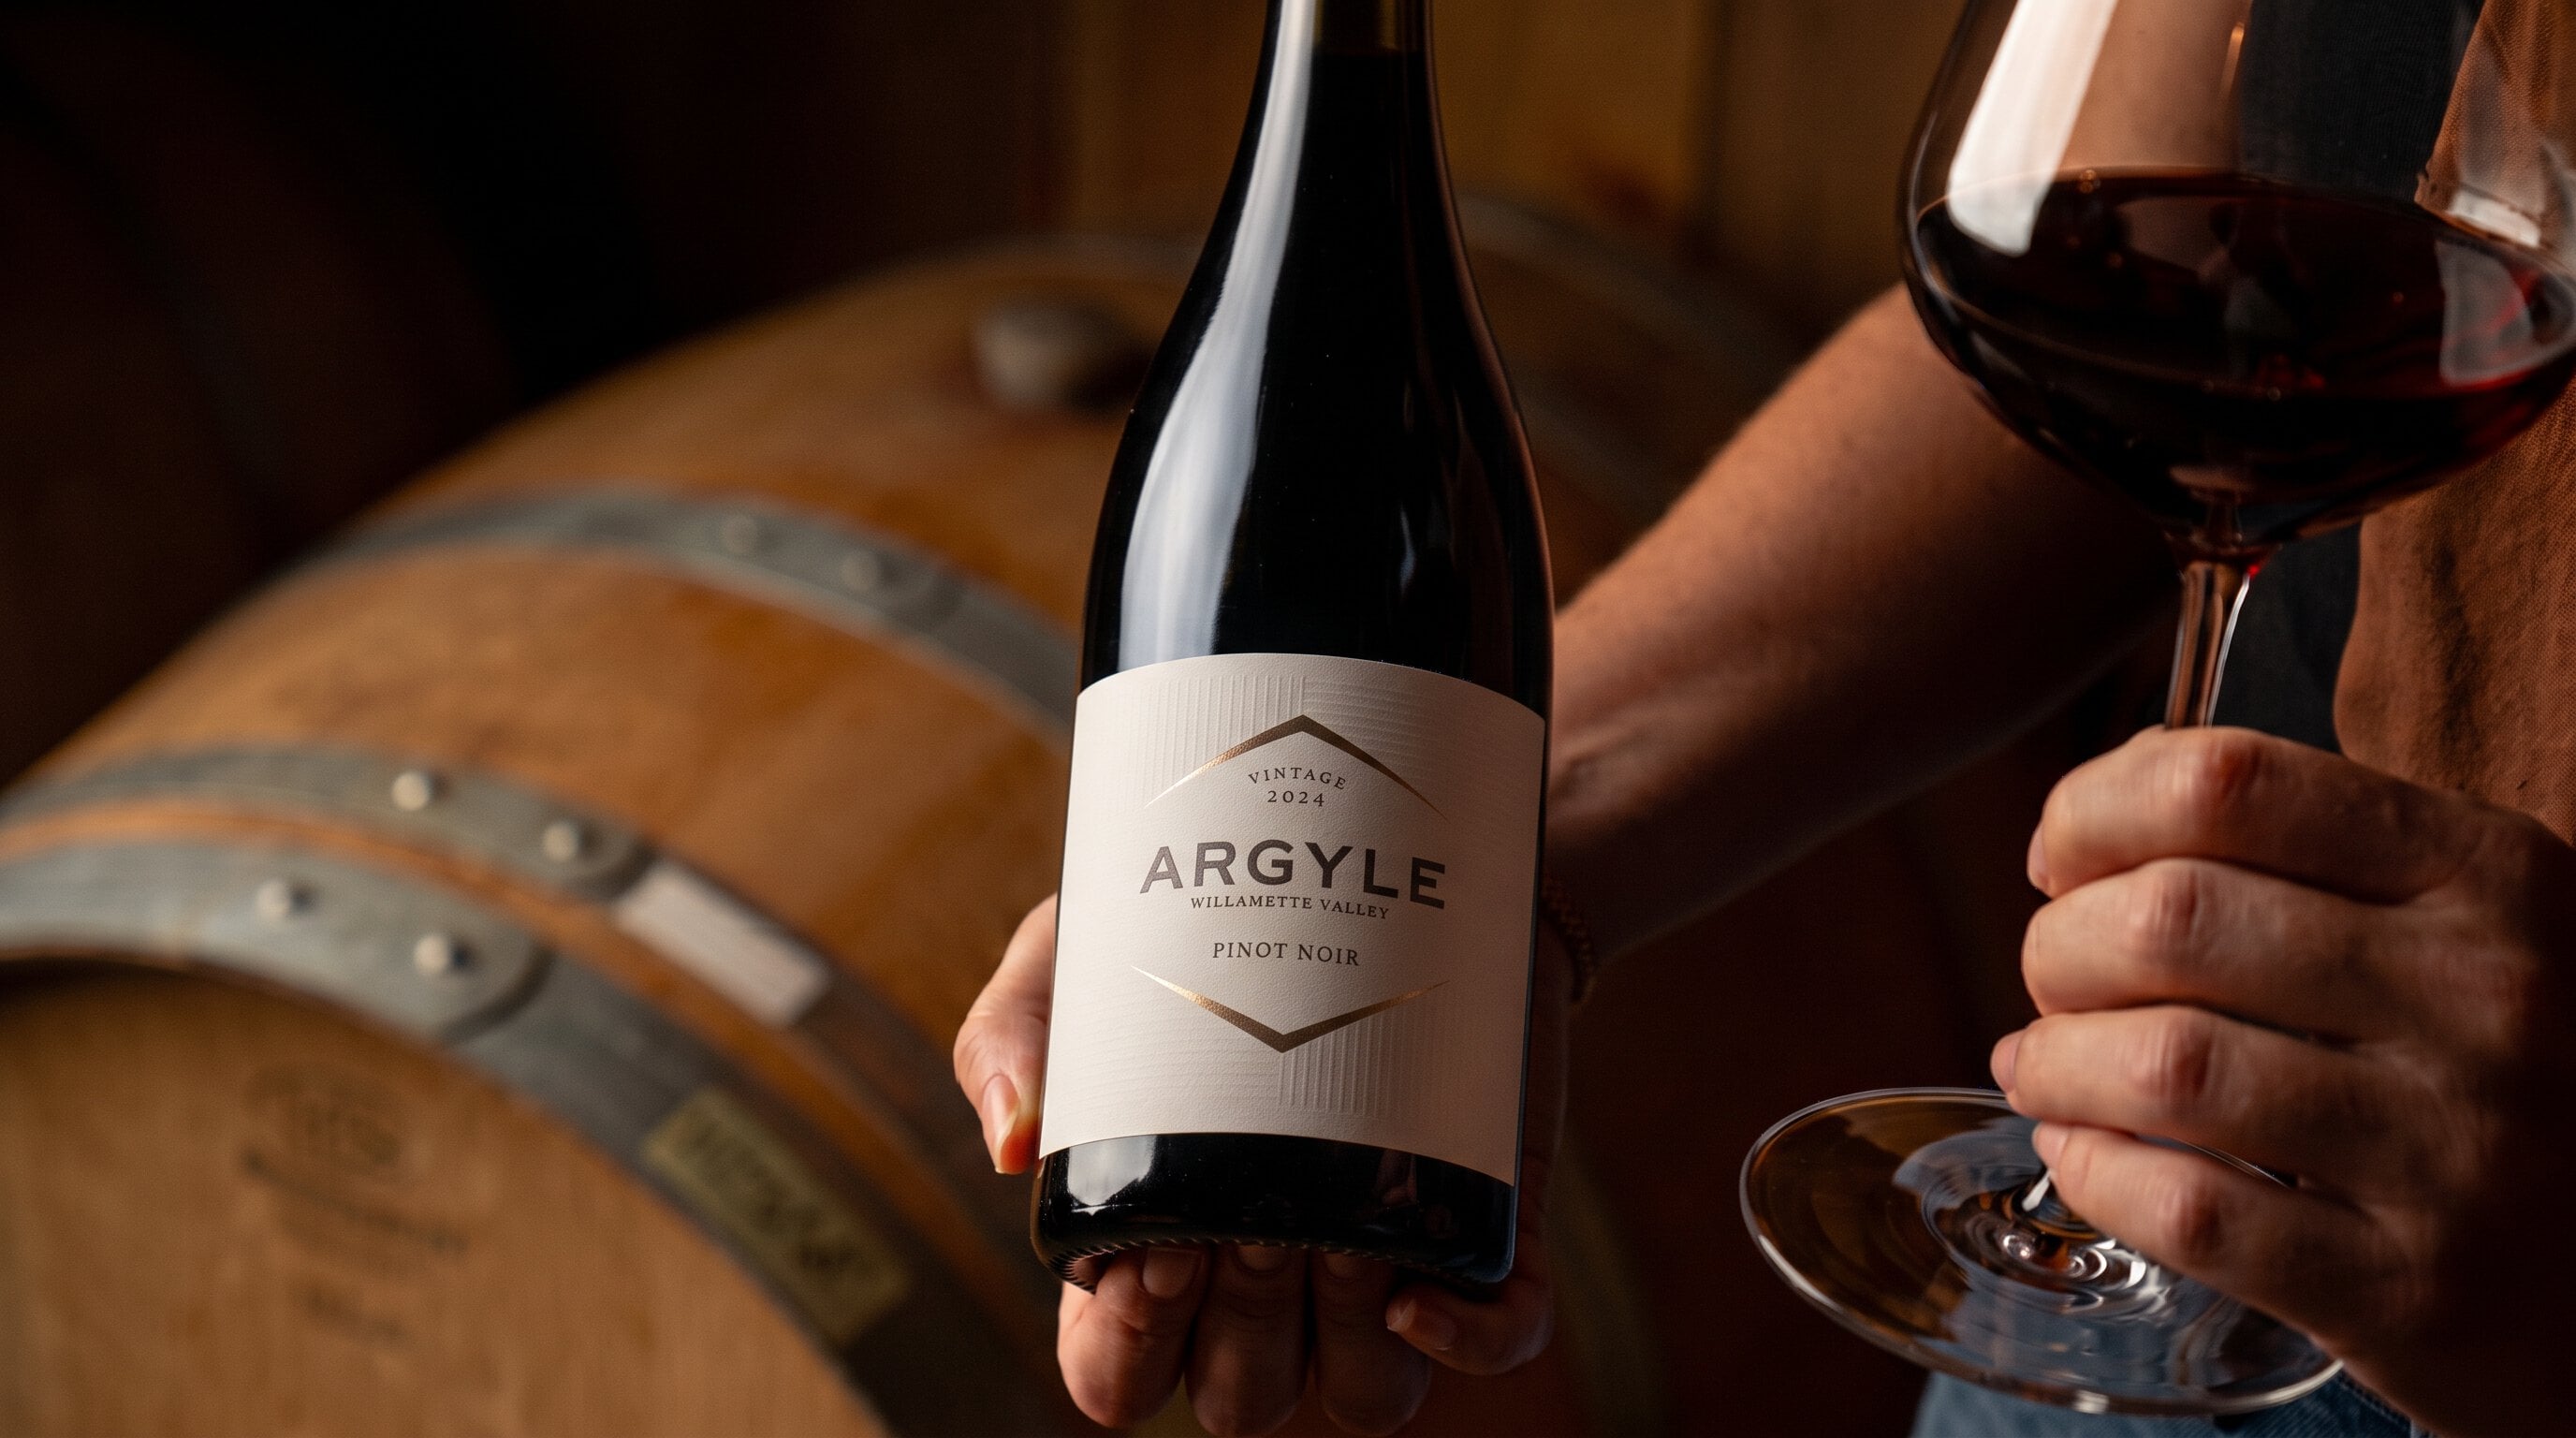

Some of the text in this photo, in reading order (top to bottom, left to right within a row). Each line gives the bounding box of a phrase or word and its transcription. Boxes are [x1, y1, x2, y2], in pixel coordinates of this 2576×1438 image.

[1248, 767, 1347, 790] VINTAGE
[1266, 790, 1325, 807] 2024
[1139, 839, 1446, 910] ARGYLE
[1191, 895, 1389, 919] WILLAMETTE VALLEY
[1212, 942, 1359, 966] PINOT NOIR
